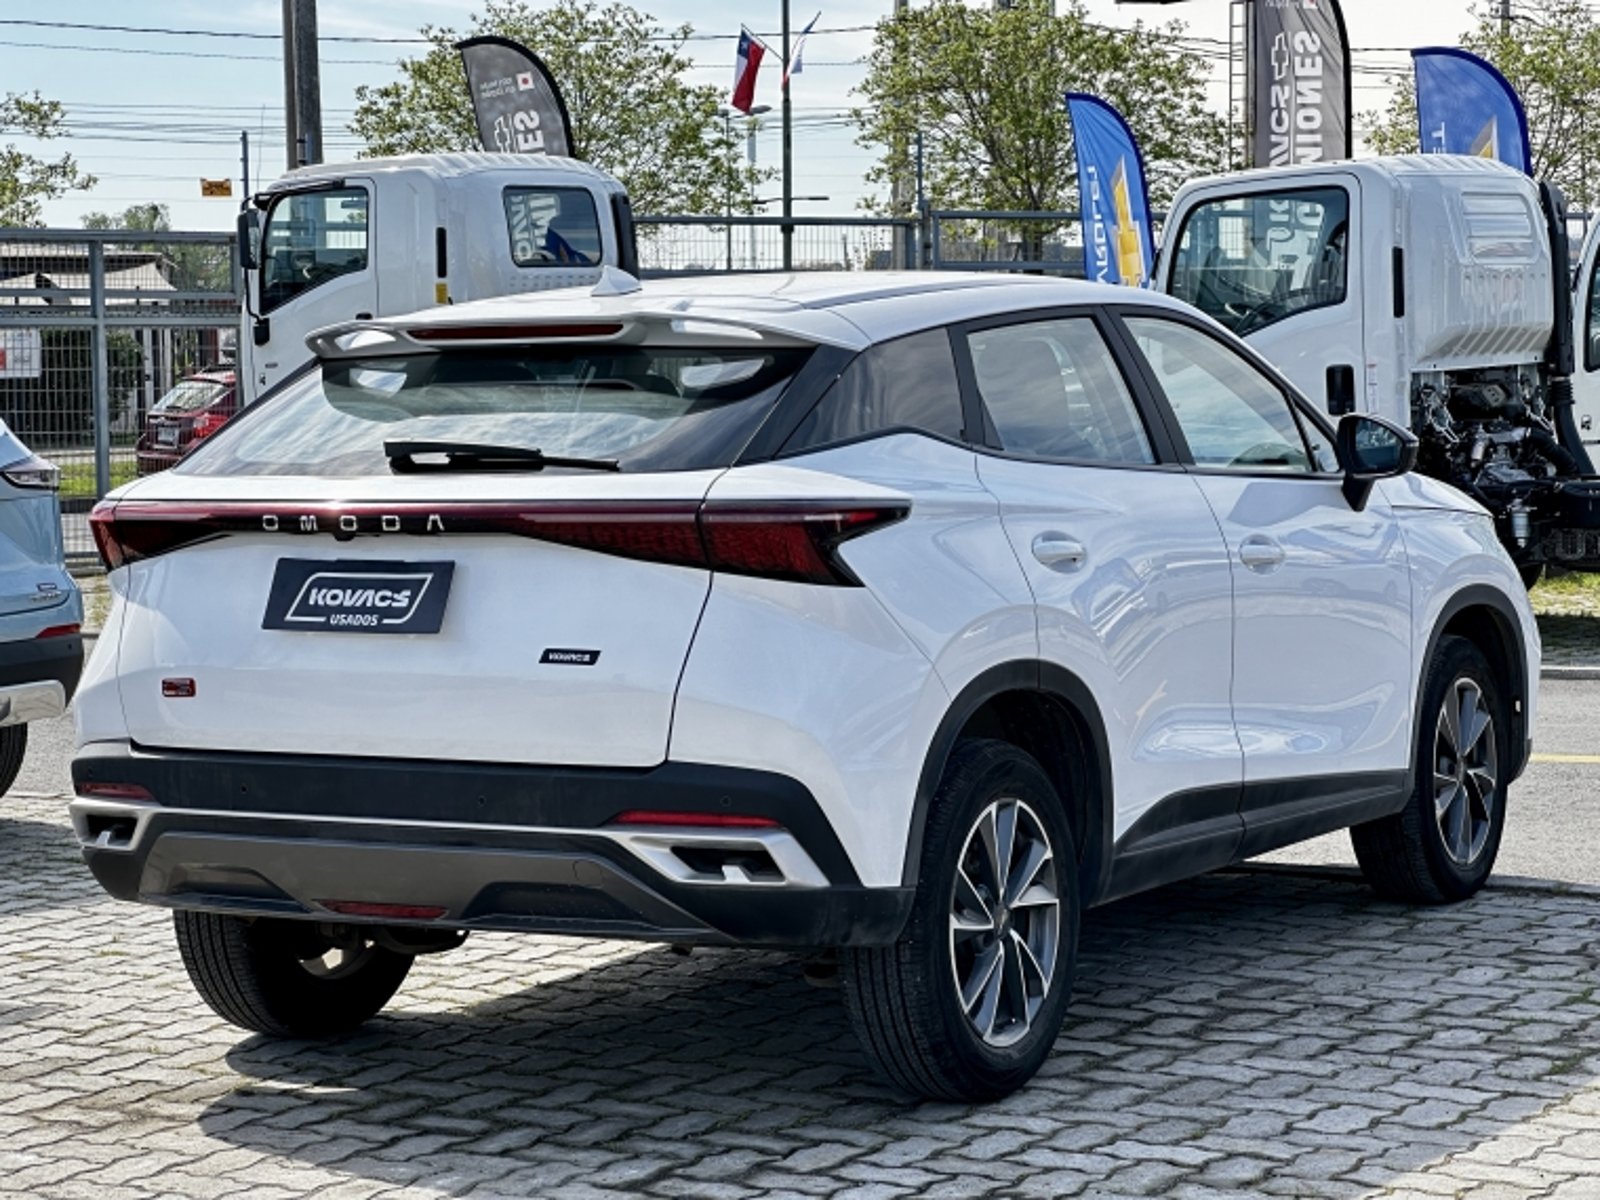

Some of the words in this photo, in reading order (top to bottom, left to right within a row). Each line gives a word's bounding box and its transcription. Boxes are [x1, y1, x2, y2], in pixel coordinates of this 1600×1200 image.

[262, 514, 445, 531] OMODA
[308, 587, 412, 608] KOVACS
[329, 614, 379, 626] USADOS
